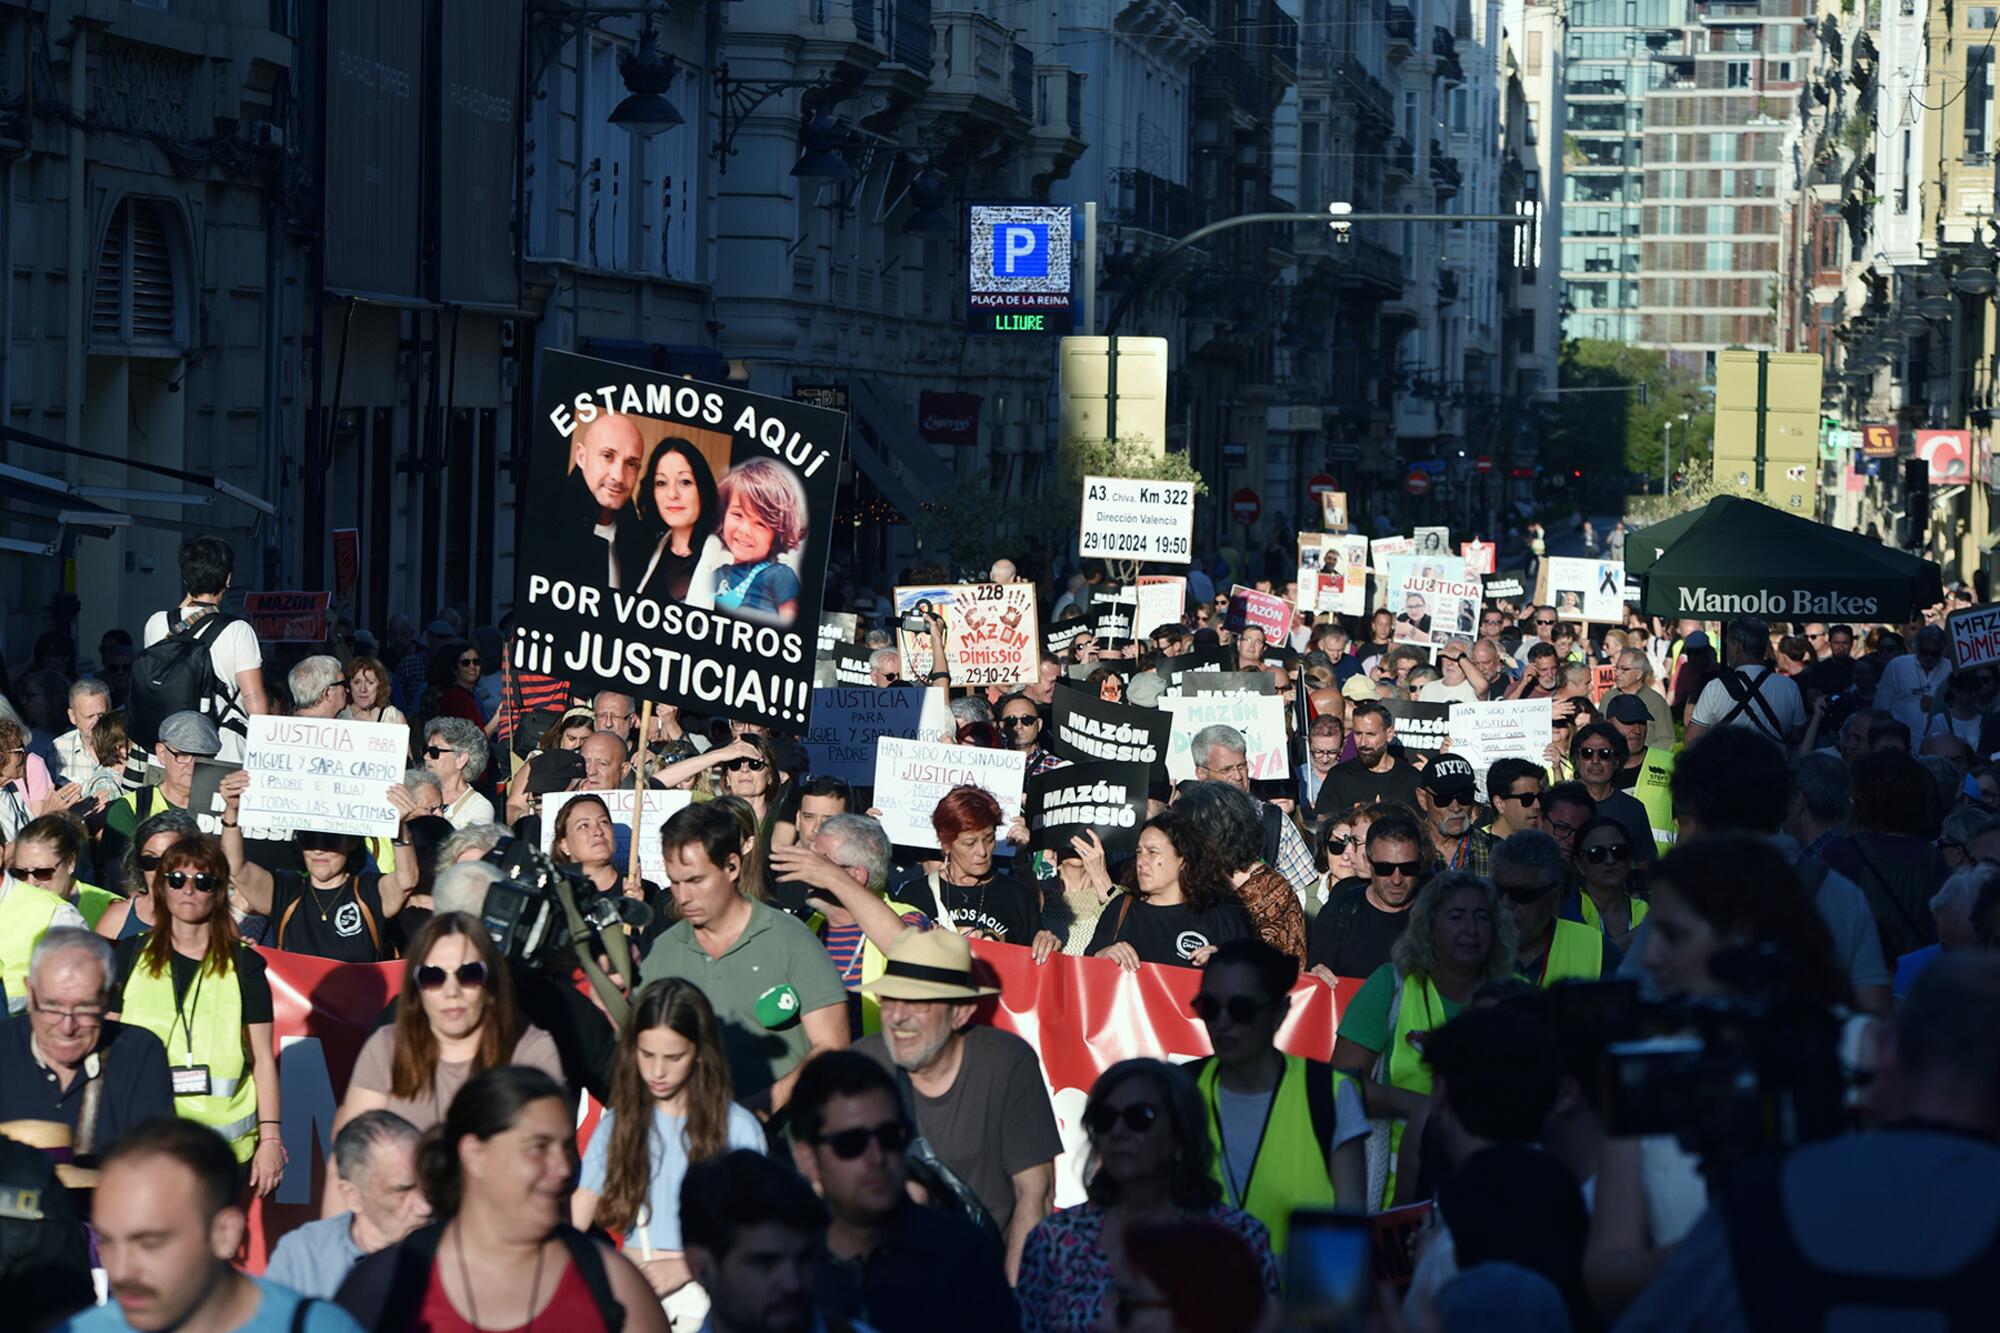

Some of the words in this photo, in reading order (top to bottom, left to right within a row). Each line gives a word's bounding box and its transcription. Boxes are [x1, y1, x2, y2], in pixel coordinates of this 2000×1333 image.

[1005, 227, 1035, 272] P
[971, 295, 1004, 307] PLAÇA
[1006, 296, 1020, 305] DE
[1022, 296, 1035, 305] LA
[1037, 296, 1069, 305] REINA
[995, 315, 1044, 330] LLIURE
[550, 383, 724, 438] ESTAMOS
[733, 406, 831, 478] AQUÍ
[1140, 488, 1160, 503] Km
[1164, 489, 1188, 505] 322
[1096, 511, 1137, 523] Dirección
[1140, 514, 1178, 526] Valencia
[1084, 532, 1148, 551] 29/10/2024
[1155, 536, 1187, 554] 19:50
[977, 584, 1004, 601] 228
[1403, 577, 1480, 598] JUSTICIA
[1678, 586, 1786, 614] Manolo
[1792, 589, 1878, 615] Bakes
[528, 575, 600, 617] POR
[613, 592, 803, 663] VOSOTROS
[1954, 611, 2000, 636] MAZ
[966, 665, 1021, 683] 29-10-24
[852, 712, 886, 723] PARA
[1485, 706, 1505, 716] SIDO
[266, 722, 353, 749] JUSTICIA
[368, 737, 396, 750] PARA
[851, 728, 857, 739] Y
[1068, 712, 1149, 745] MAZÓN
[1059, 725, 1157, 763] DIMISSIÓ
[828, 747, 868, 761] PADRE
[881, 742, 903, 756] HAN
[912, 746, 938, 760] SIDO
[943, 750, 1022, 770] ASESINADOS
[249, 751, 292, 769] MIGUEL
[299, 755, 306, 769] Y
[308, 757, 343, 774] SARA
[351, 760, 397, 779] CARPIO
[1434, 760, 1471, 777] NYPD
[315, 781, 323, 791] E
[1043, 780, 1127, 809] MAZÓN
[260, 796, 300, 811] TODAS
[307, 801, 329, 814] LAS
[911, 801, 931, 811] SAR
